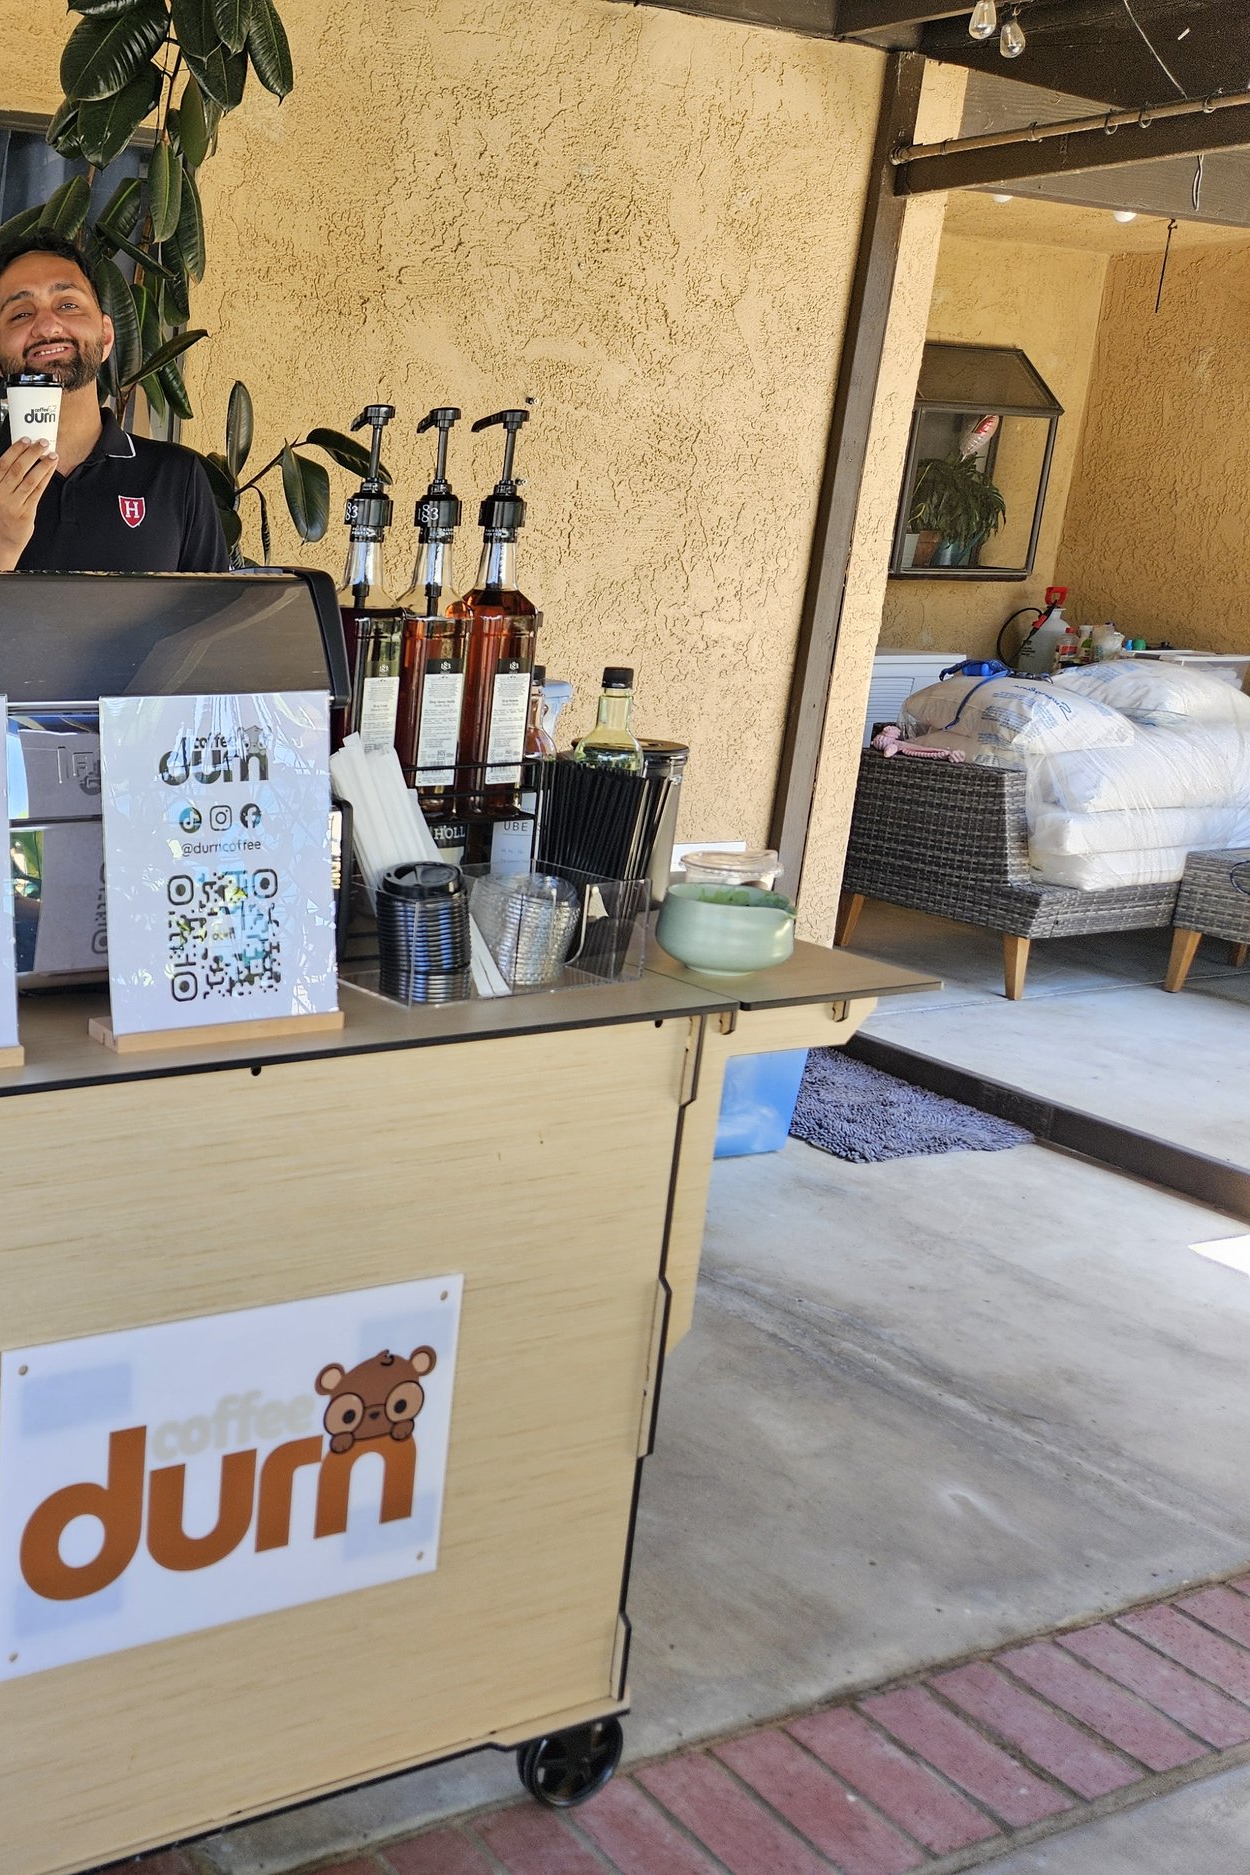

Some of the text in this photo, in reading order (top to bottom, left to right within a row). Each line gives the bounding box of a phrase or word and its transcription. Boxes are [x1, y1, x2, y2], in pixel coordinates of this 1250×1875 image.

[125, 501, 140, 518] H
[504, 821, 528, 831] UBE
[152, 1389, 315, 1461] coffee
[19, 1425, 417, 1602] durn
